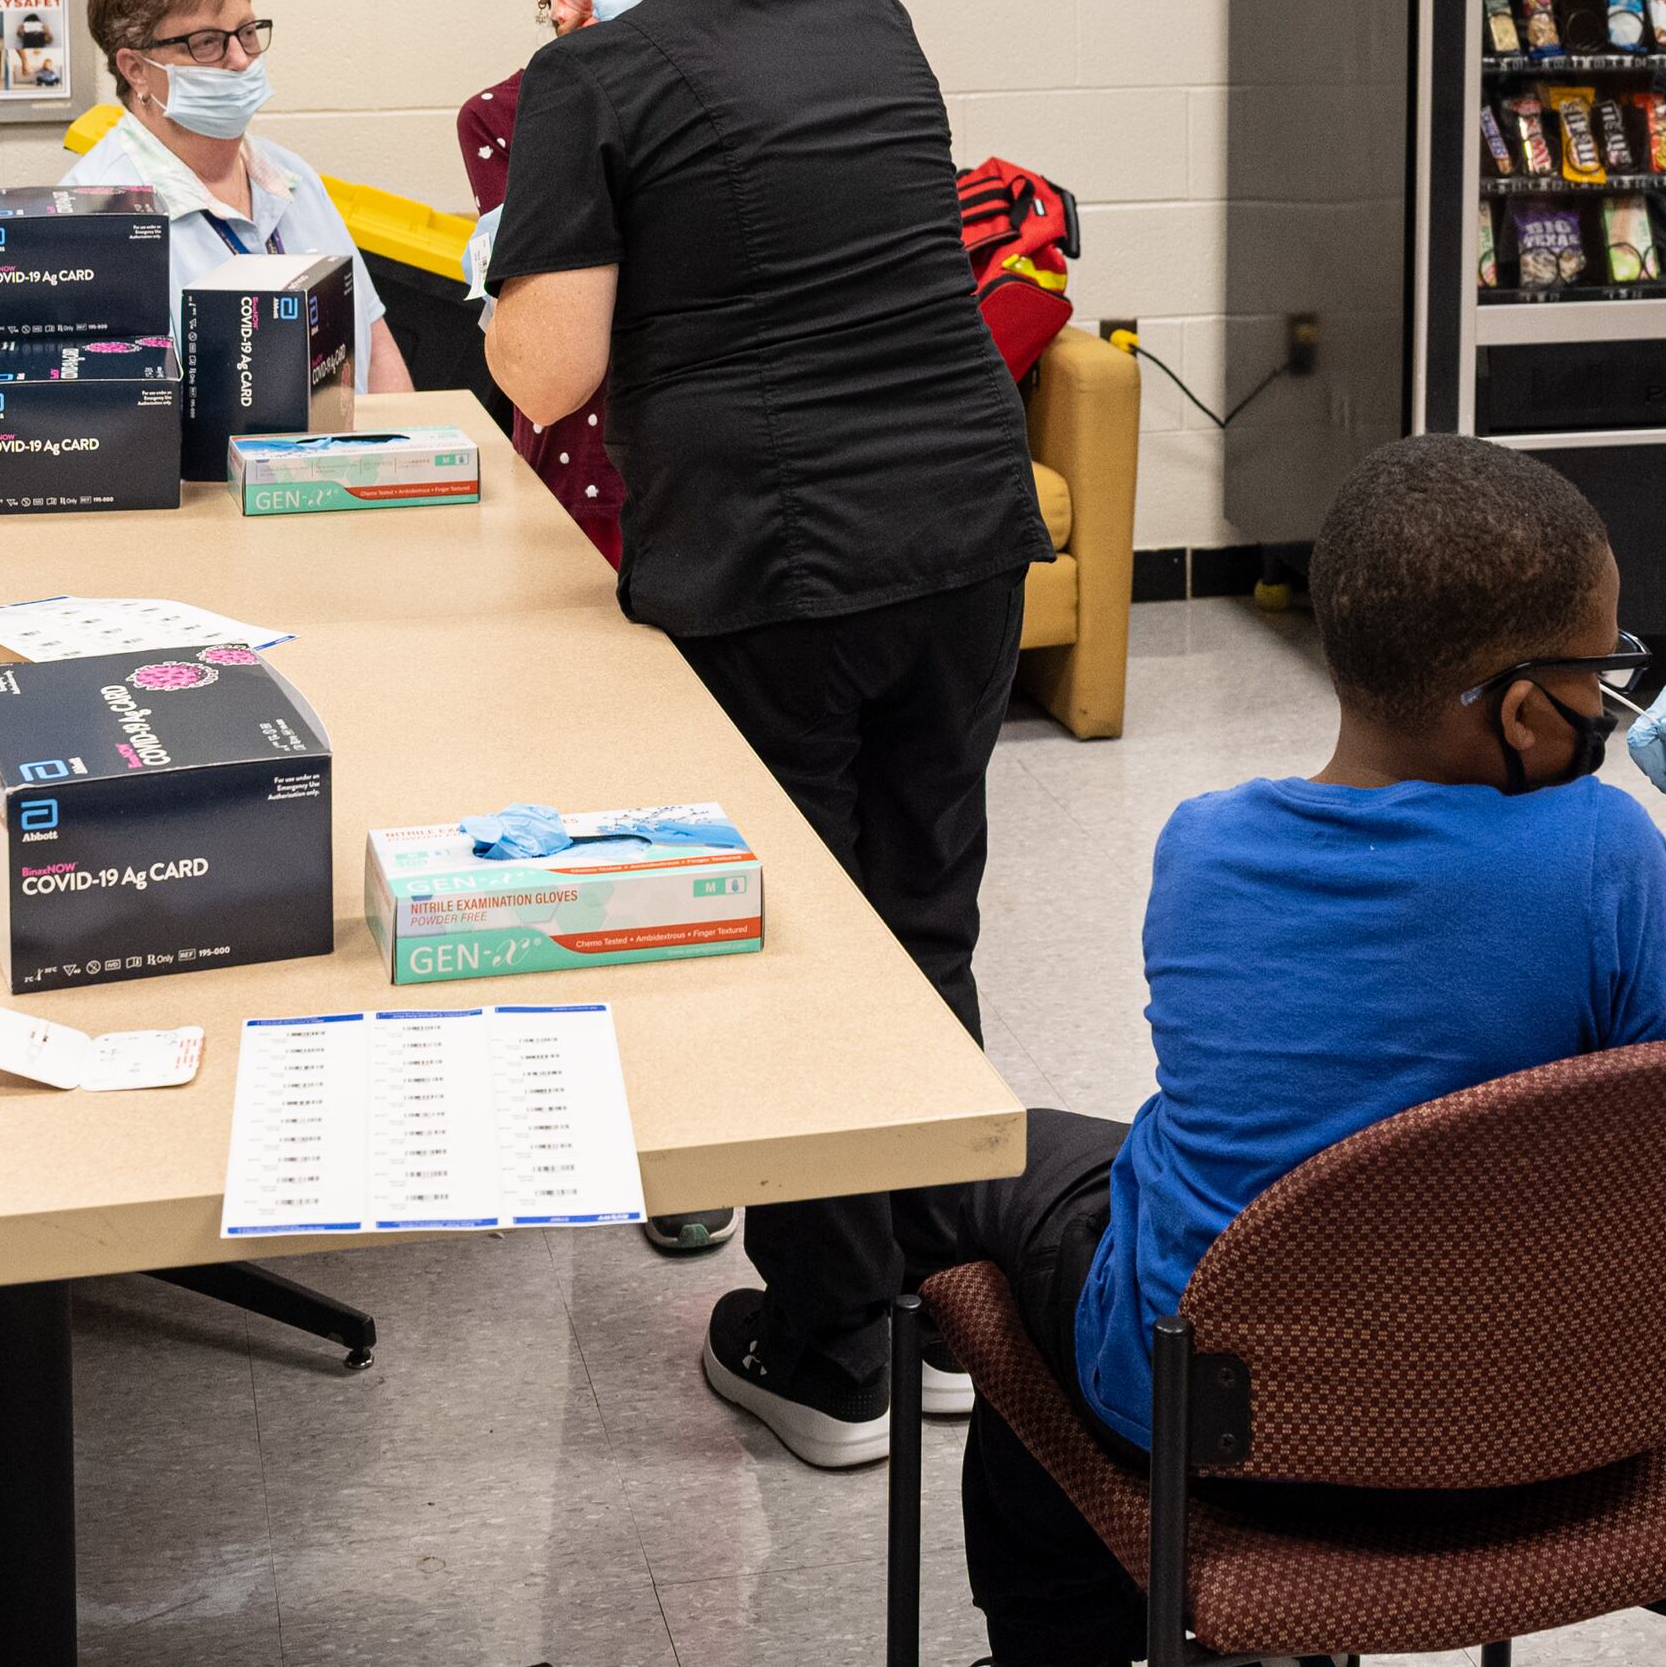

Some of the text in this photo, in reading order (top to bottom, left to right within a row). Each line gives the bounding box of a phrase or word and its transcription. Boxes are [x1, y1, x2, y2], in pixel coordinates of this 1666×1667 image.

[1526, 219, 1572, 233] BIG
[1523, 234, 1579, 247] TEXAS
[42, 272, 58, 286] Ag
[59, 269, 94, 282] CARD
[236, 296, 253, 407] COVID-19 Ag CARD
[43, 439, 60, 455] Ag
[61, 438, 99, 451] CARD
[277, 783, 308, 792] Emergency
[268, 791, 306, 800] Authorization
[22, 830, 58, 843] Abbott
[21, 857, 209, 896] COVID-19 Ag CARD
[410, 889, 578, 915] NITRILE EXAMINATION GLOVES
[410, 911, 487, 926] POWDER FREE
[575, 925, 748, 949] Chemo Tested Ambidextrous Finger Textured
[199, 946, 230, 958] 195-000
